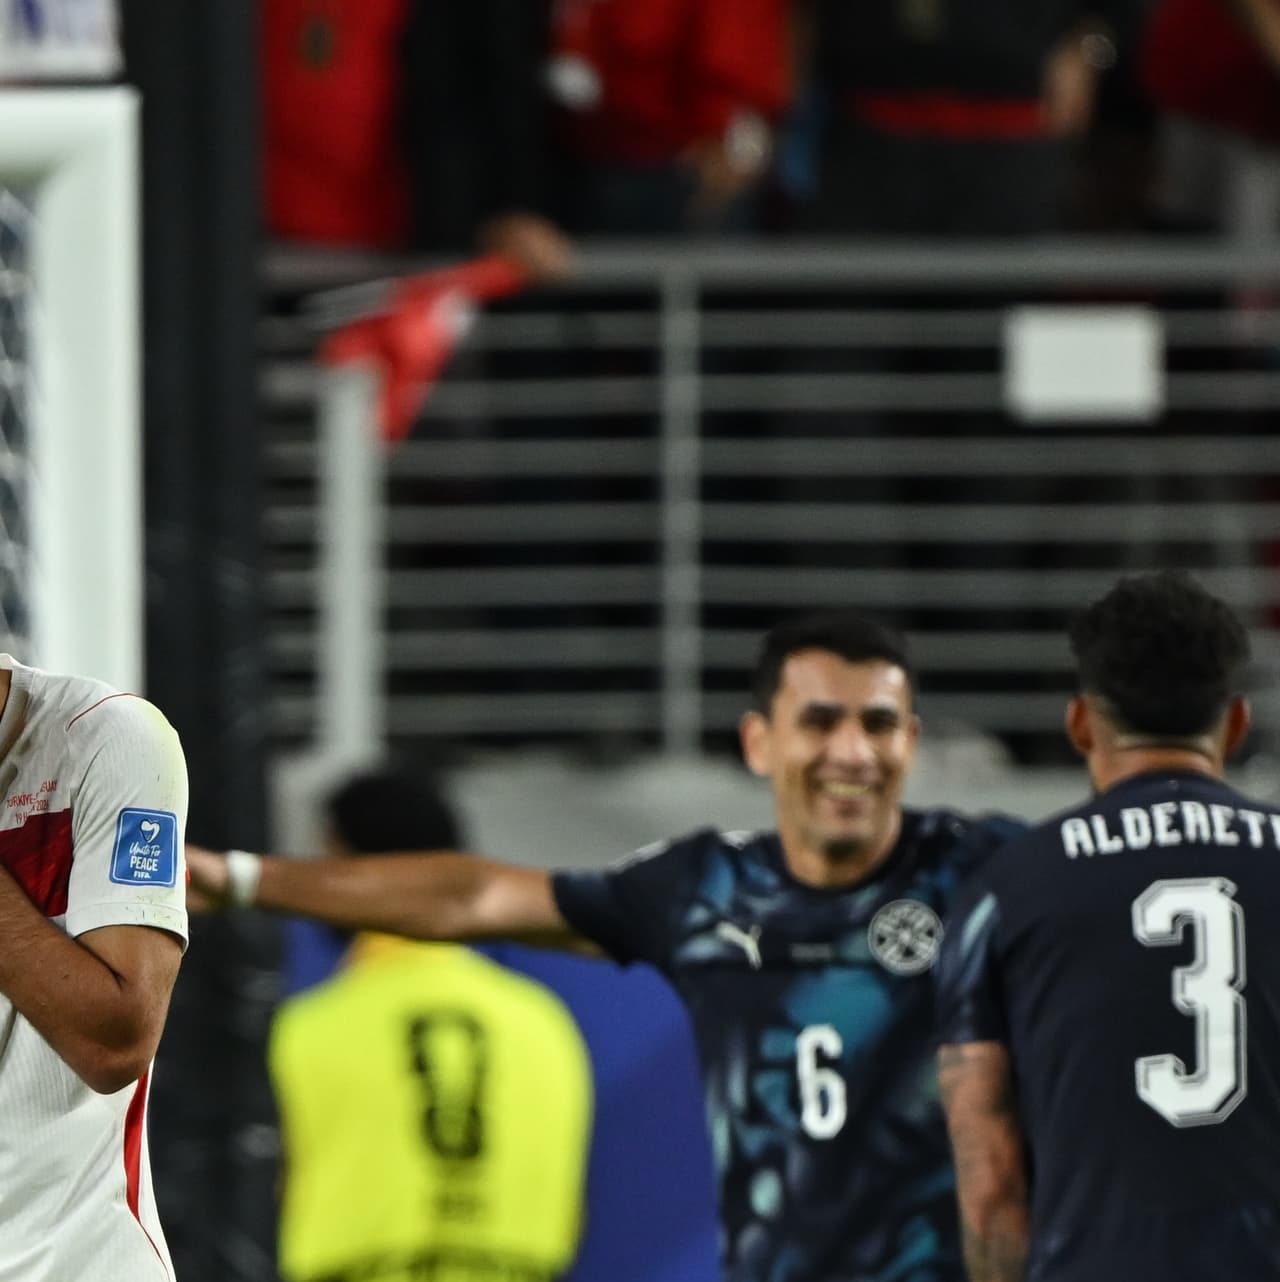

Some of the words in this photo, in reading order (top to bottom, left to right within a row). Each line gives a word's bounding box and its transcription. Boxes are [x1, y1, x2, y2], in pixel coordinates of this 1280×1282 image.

[130, 855, 158, 872] PEACE
[134, 870, 151, 879] FIFA
[1131, 876, 1247, 1128] 3
[796, 1023, 847, 1140] 6
